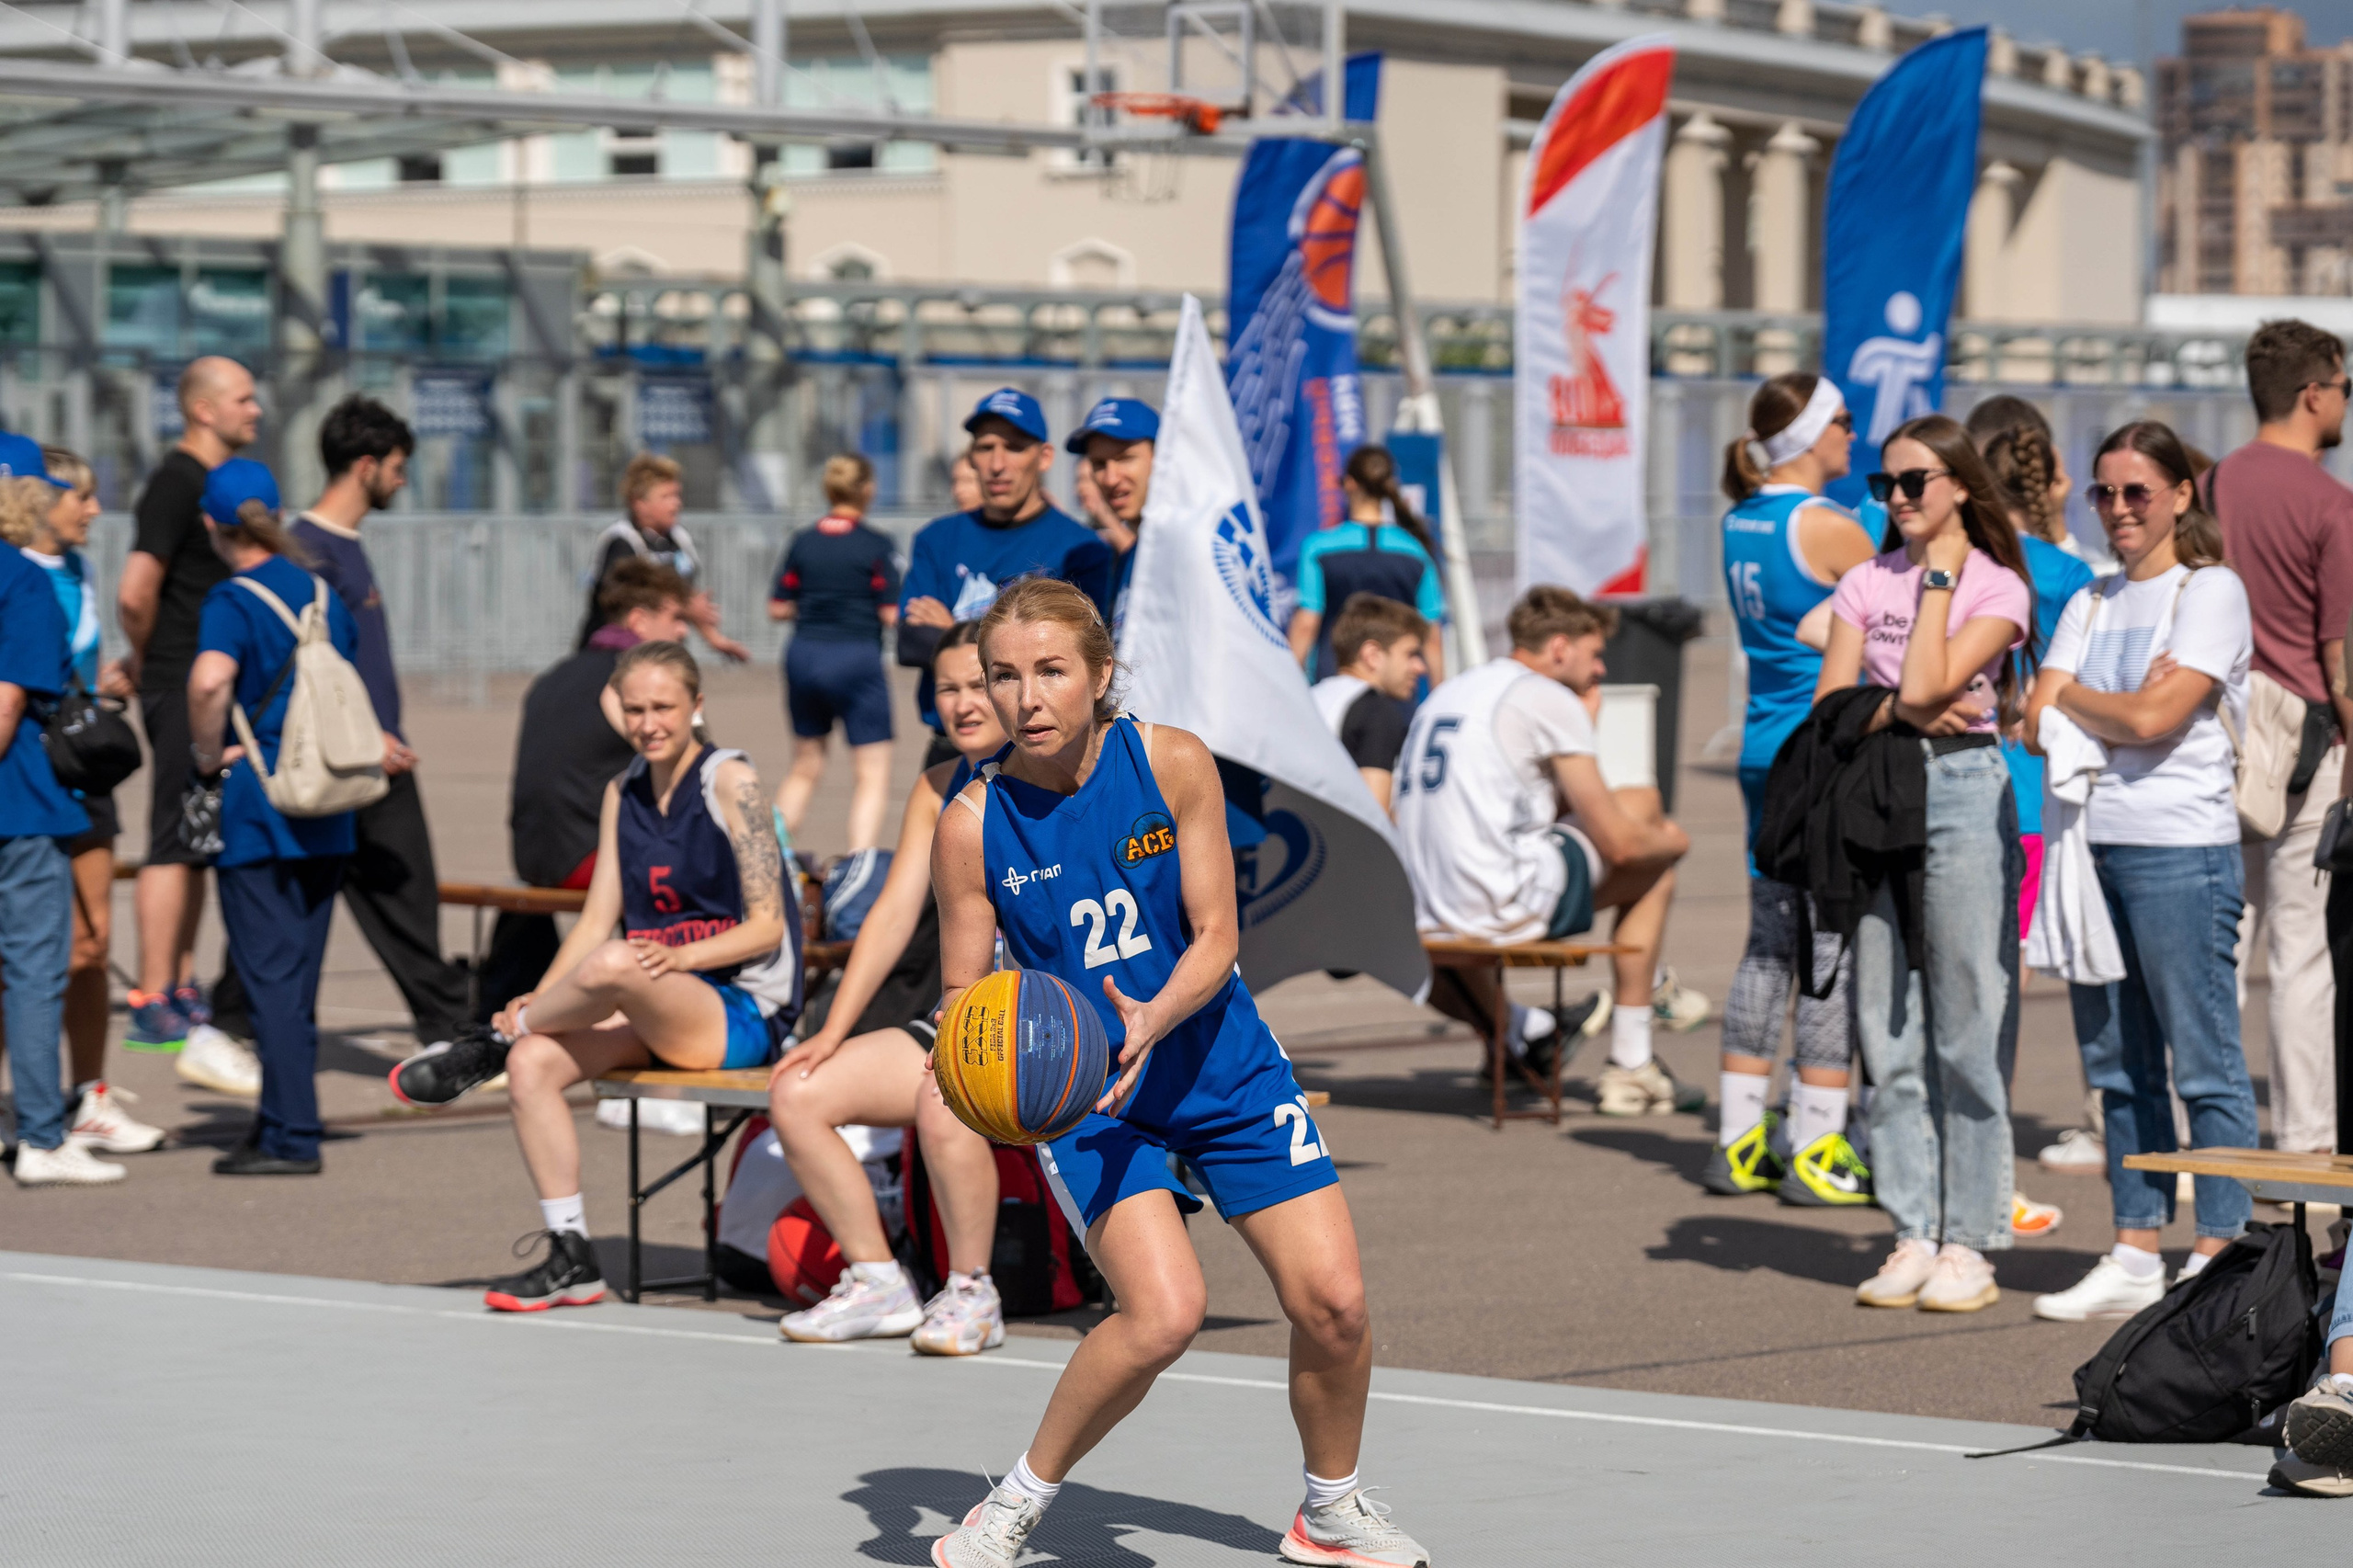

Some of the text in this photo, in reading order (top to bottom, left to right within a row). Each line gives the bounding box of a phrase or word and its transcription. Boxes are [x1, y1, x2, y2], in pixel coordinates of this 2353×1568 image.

[1730, 560, 1766, 620] 15
[1883, 609, 1908, 628] be
[649, 866, 682, 914] 5
[1070, 888, 1153, 970] 22
